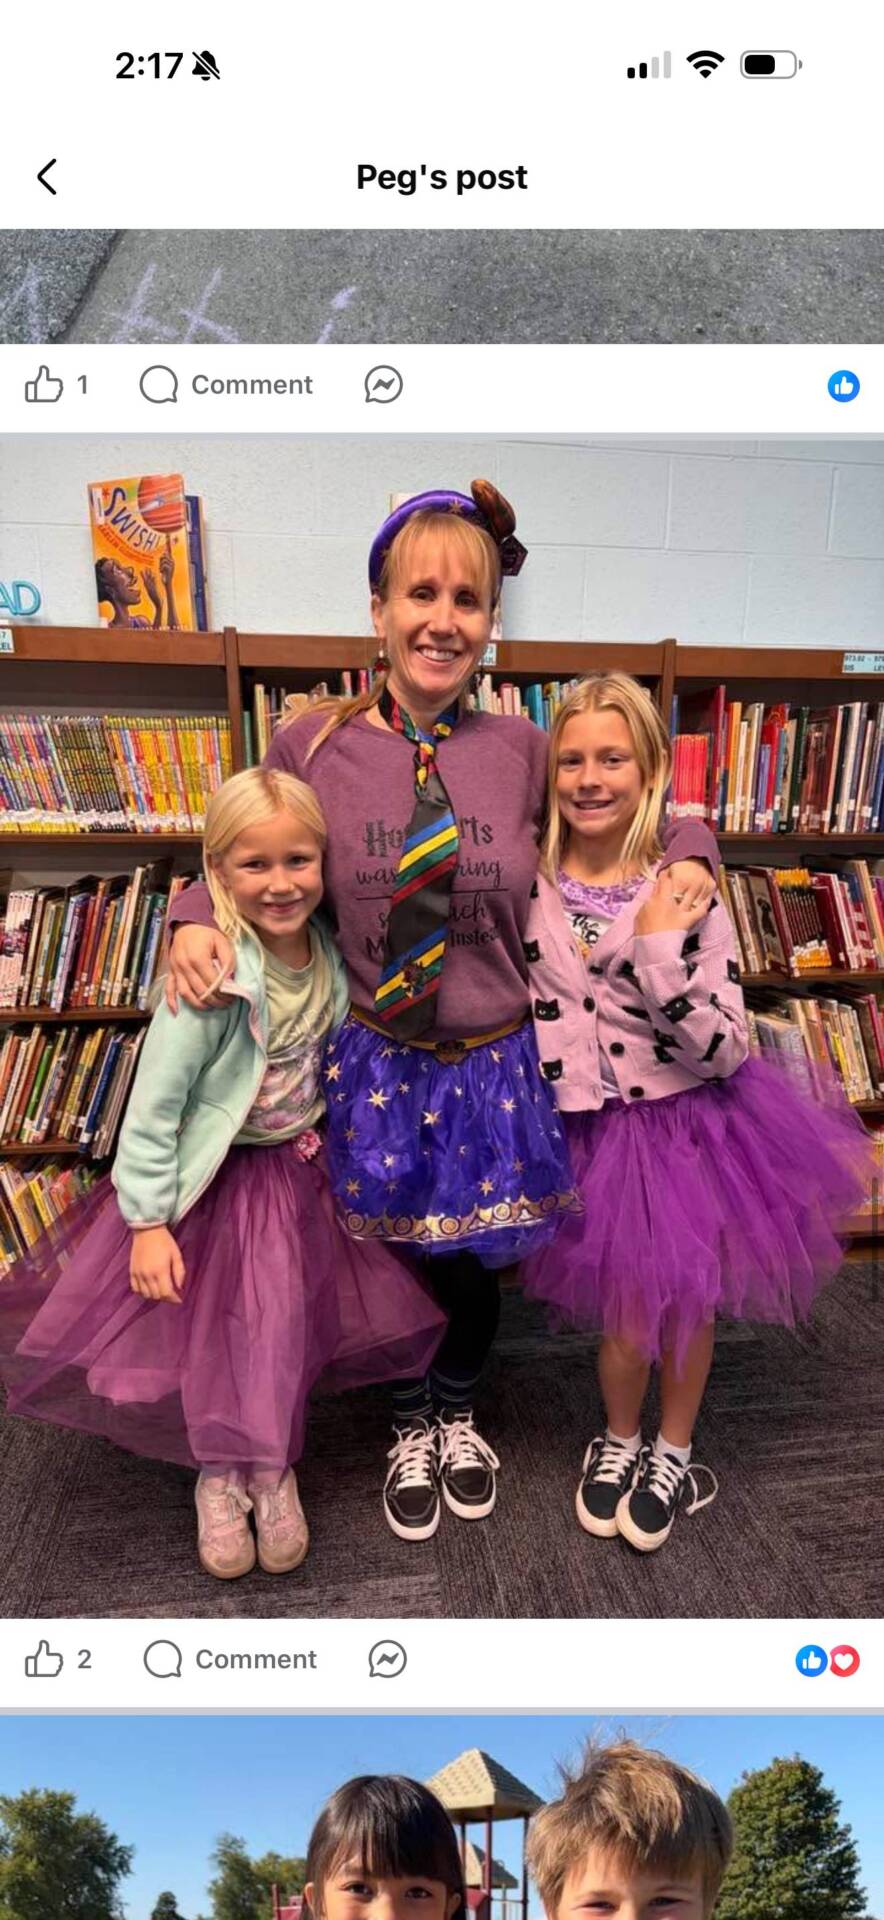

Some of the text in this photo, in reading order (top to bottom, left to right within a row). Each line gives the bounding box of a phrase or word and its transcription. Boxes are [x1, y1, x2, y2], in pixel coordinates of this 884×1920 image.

[115, 52, 184, 80] 2:17
[357, 164, 529, 196] Peg's post
[77, 374, 87, 395] 1
[191, 374, 313, 395] Comment
[77, 1649, 92, 1669] 2
[195, 1648, 318, 1670] Comment
